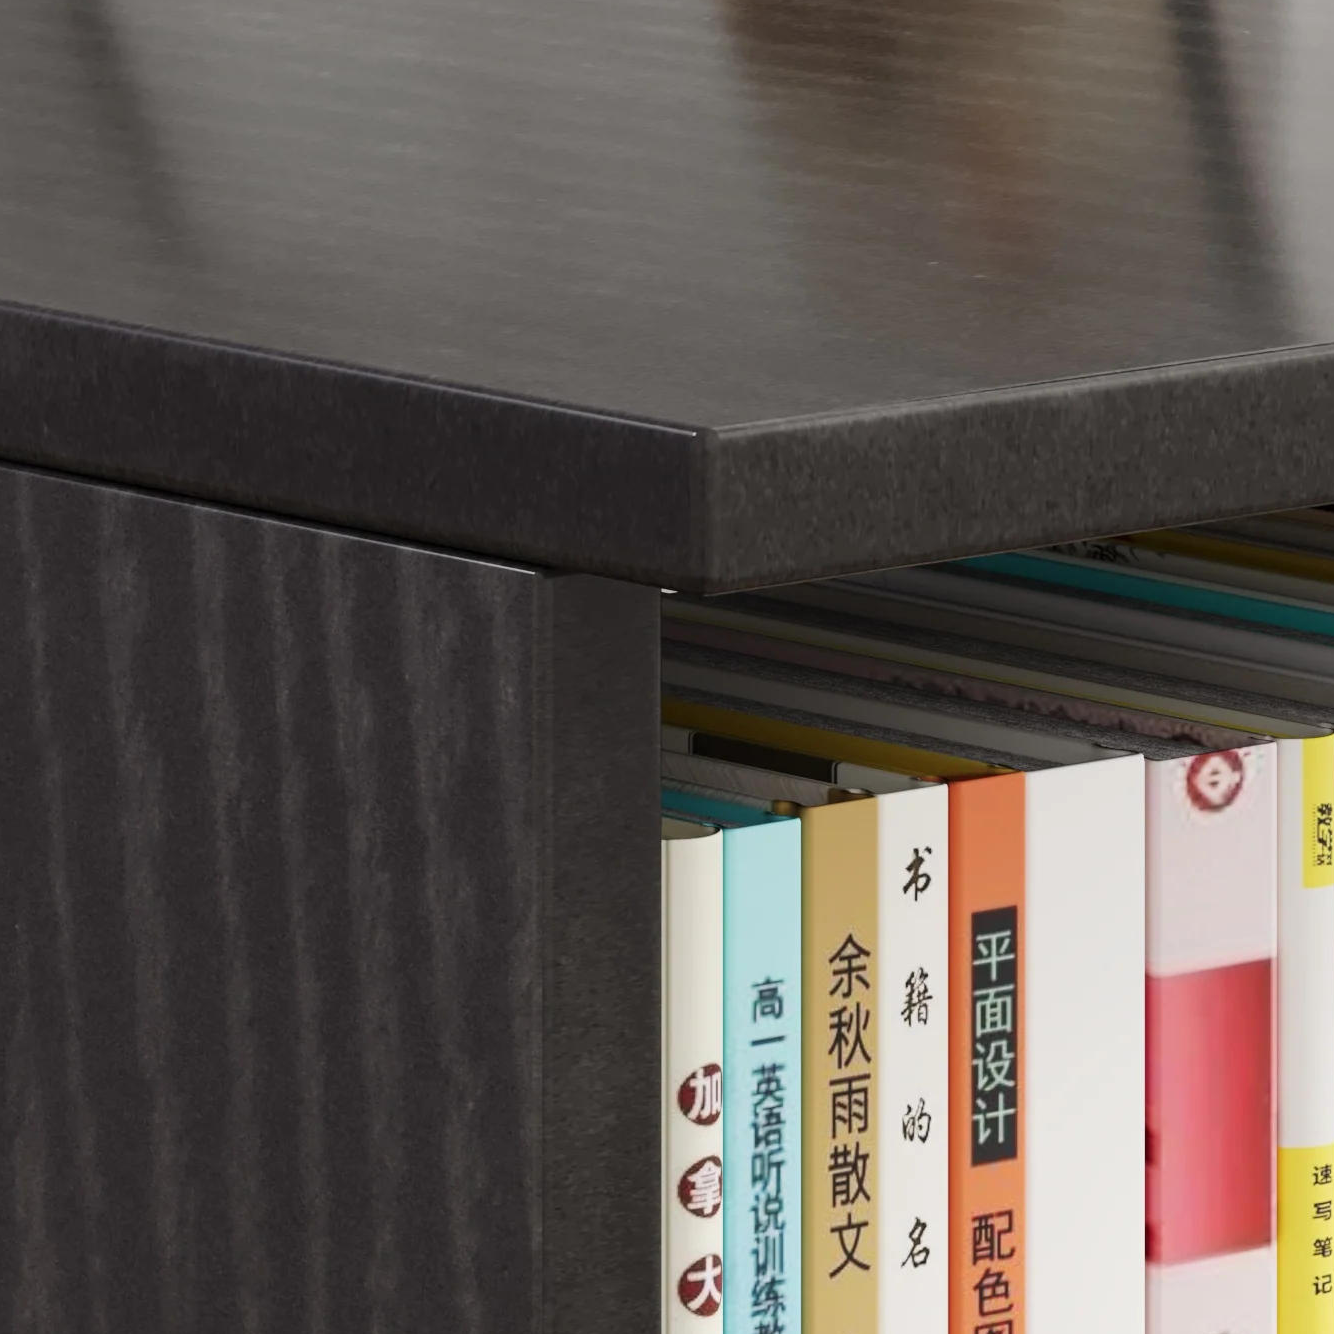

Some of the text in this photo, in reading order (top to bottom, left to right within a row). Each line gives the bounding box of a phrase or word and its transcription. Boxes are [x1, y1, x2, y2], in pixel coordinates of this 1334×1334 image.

[828, 933, 872, 1279] 余秋雨散文
[971, 929, 1017, 1145] 平面设计
[1312, 1164, 1333, 1295] 速写笔记
